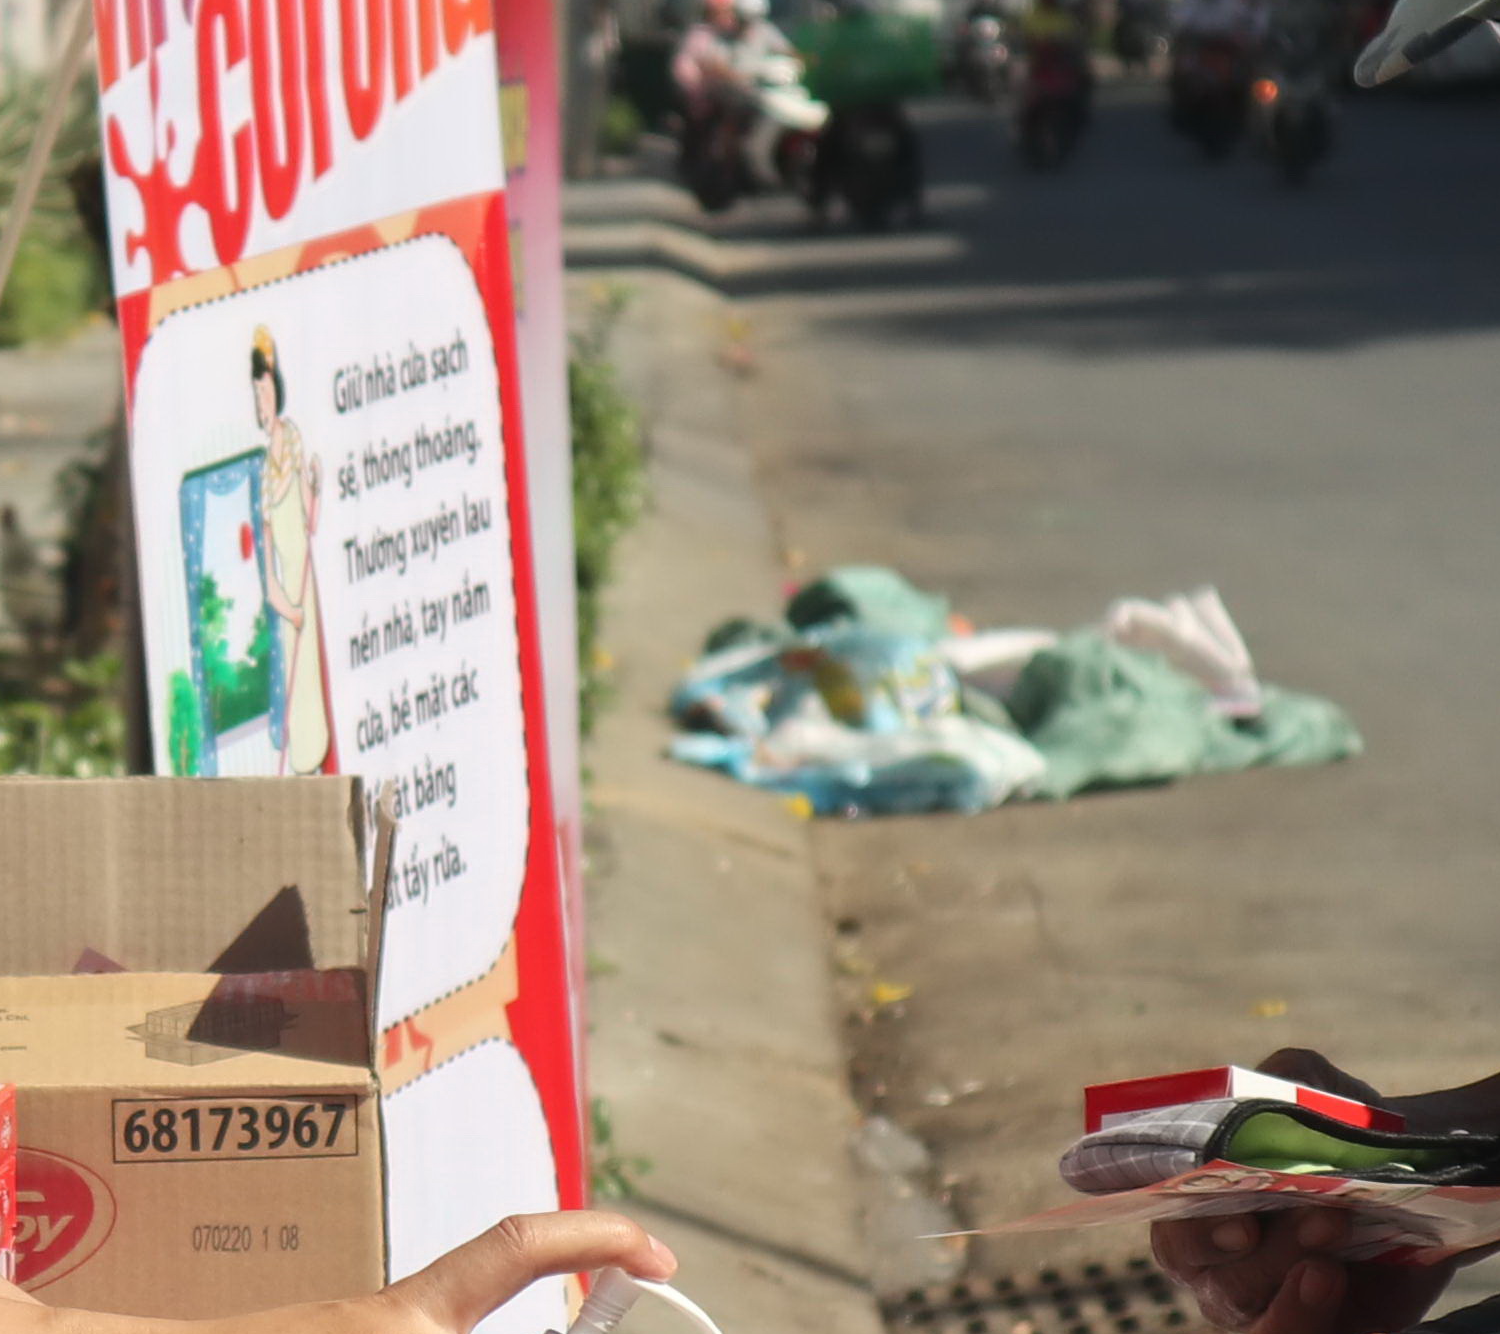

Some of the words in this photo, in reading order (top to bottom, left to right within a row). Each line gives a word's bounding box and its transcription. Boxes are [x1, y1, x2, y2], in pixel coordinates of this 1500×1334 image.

[333, 363, 363, 414] Giữ
[365, 352, 396, 404] nhà
[400, 339, 426, 392] cửa
[431, 326, 469, 391] sạch
[363, 438, 413, 488] thông
[343, 527, 407, 584] Thường
[410, 500, 461, 562] xuyên
[463, 491, 492, 537] lau
[421, 597, 448, 644] tay
[453, 568, 490, 624] nắm
[415, 673, 448, 731] mặt
[451, 660, 480, 707] các
[414, 753, 457, 809] bằng
[123, 1103, 346, 1153] 68173967
[192, 1225, 252, 1252] 070220
[262, 1225, 269, 1251] 1
[279, 1225, 299, 1251] 08
